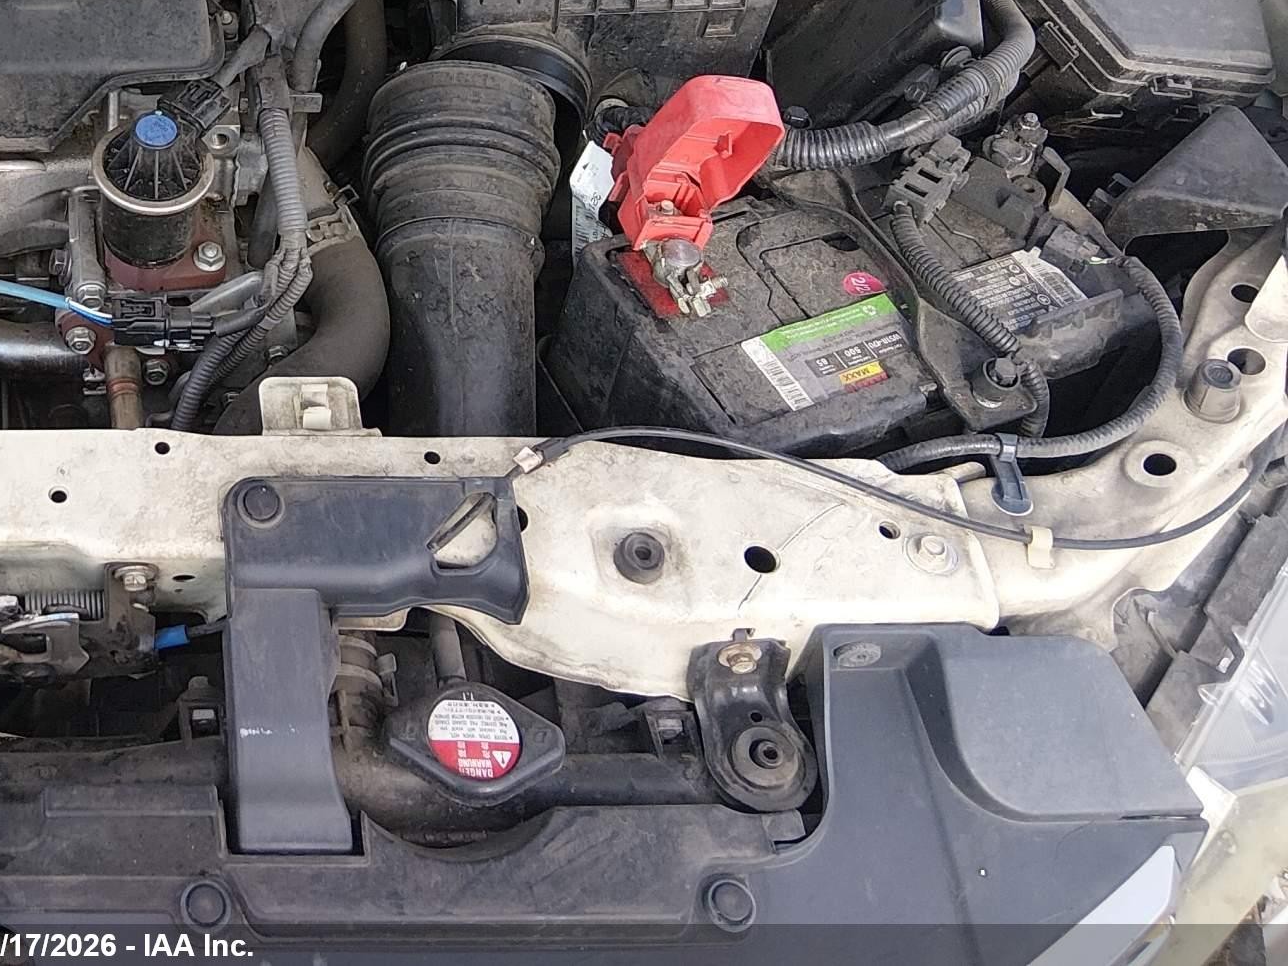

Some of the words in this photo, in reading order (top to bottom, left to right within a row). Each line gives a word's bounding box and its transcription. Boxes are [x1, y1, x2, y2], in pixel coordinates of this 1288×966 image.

[844, 367, 870, 382] MAXX
[457, 758, 493, 769] WARNING
[458, 767, 494, 778] DANGER
